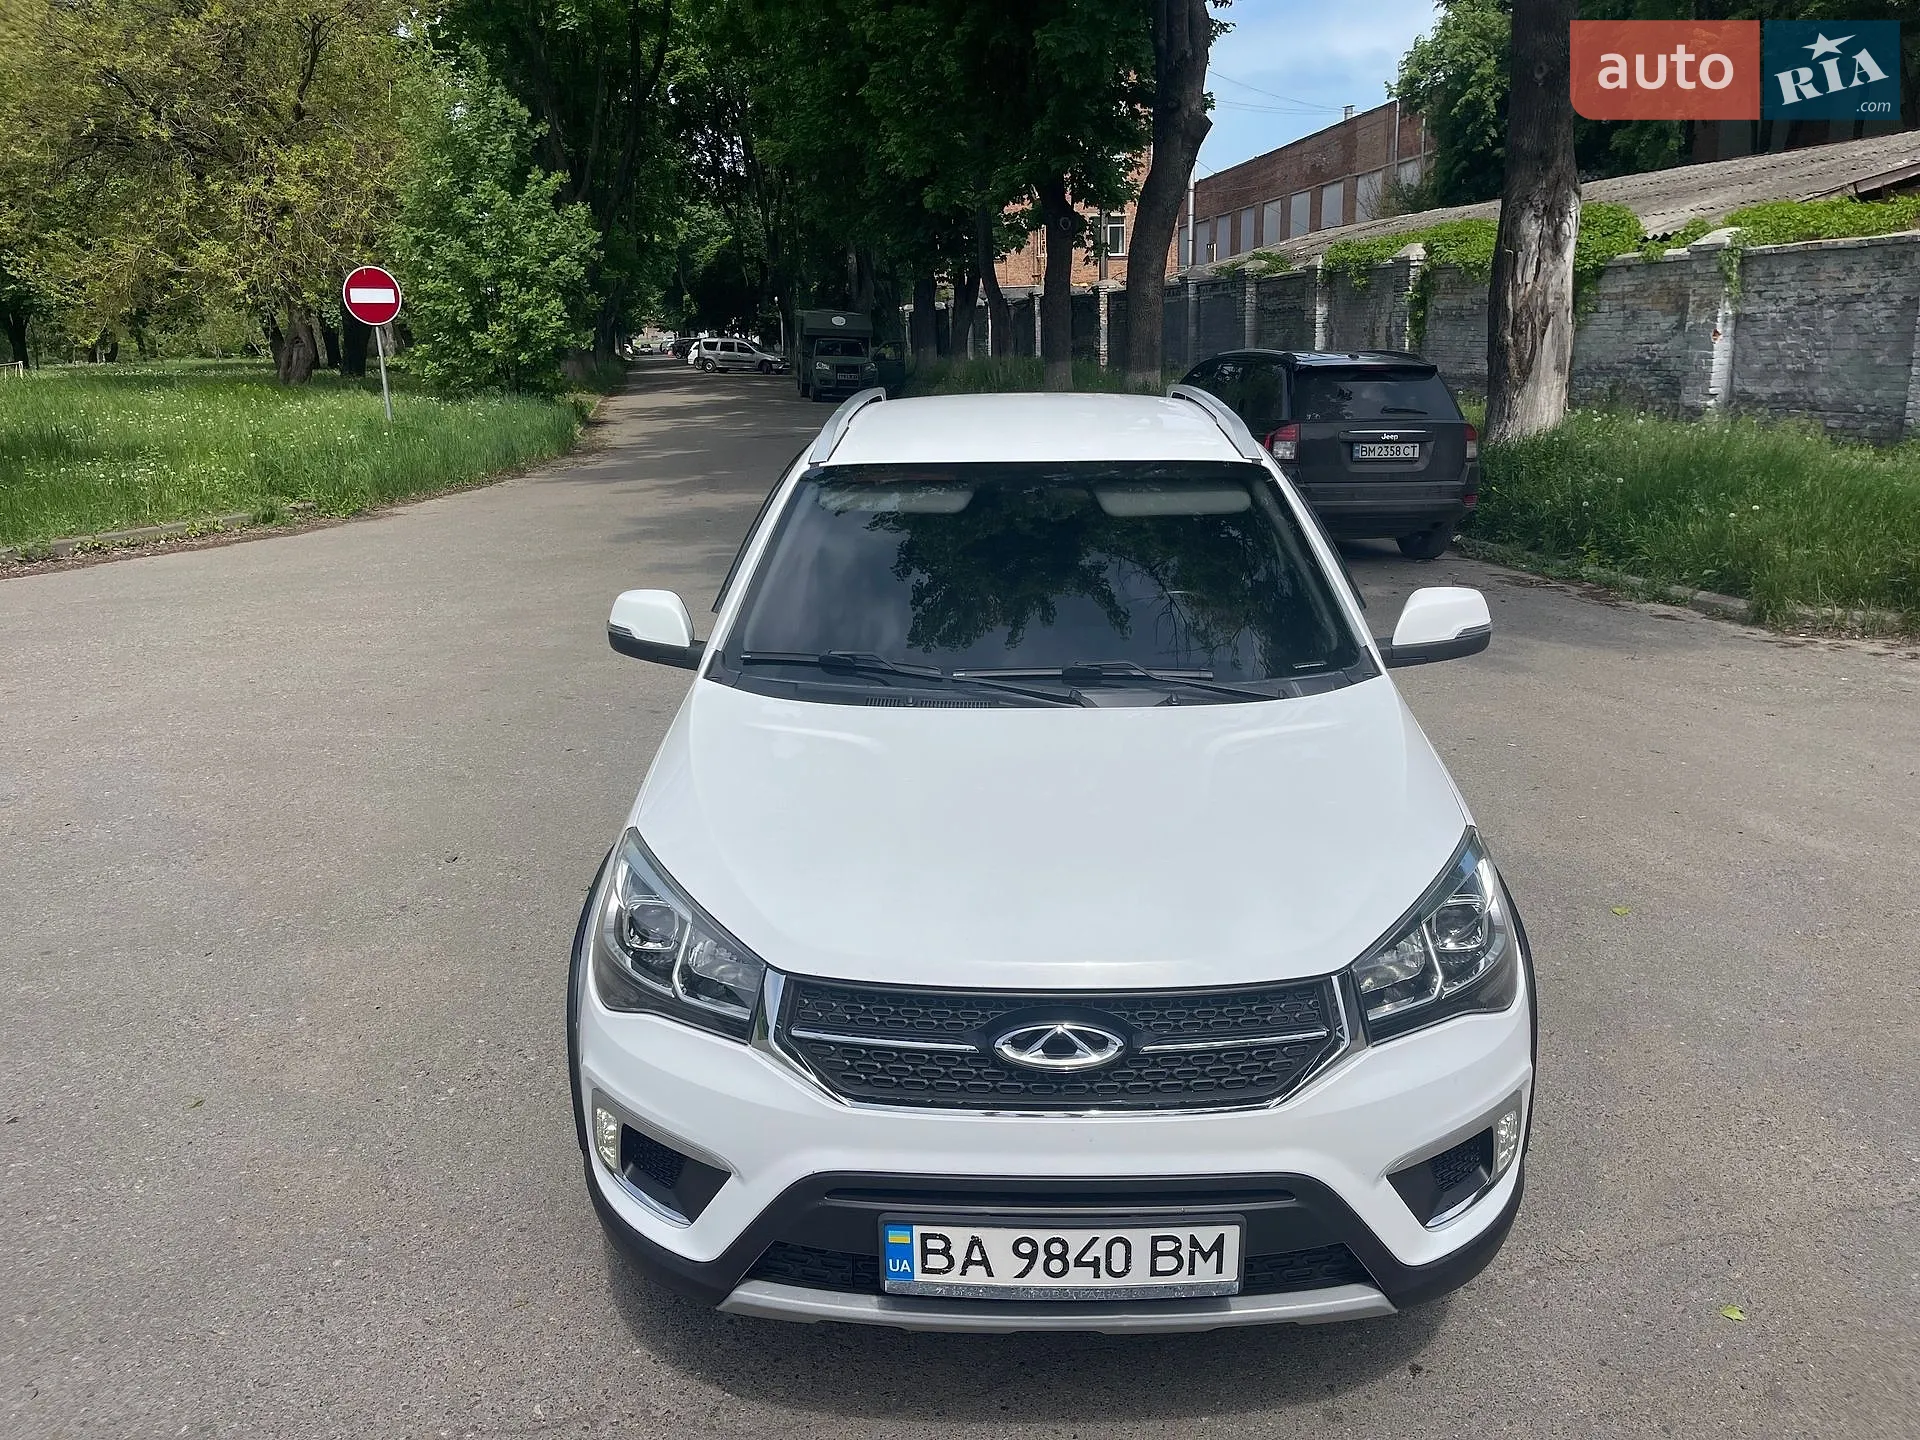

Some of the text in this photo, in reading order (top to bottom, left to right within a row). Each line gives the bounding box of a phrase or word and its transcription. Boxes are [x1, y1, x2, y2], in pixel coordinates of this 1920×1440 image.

[1381, 433, 1399, 441] Jeep
[919, 1232, 1226, 1279] BA 9840 BM
[888, 1259, 912, 1273] UA
